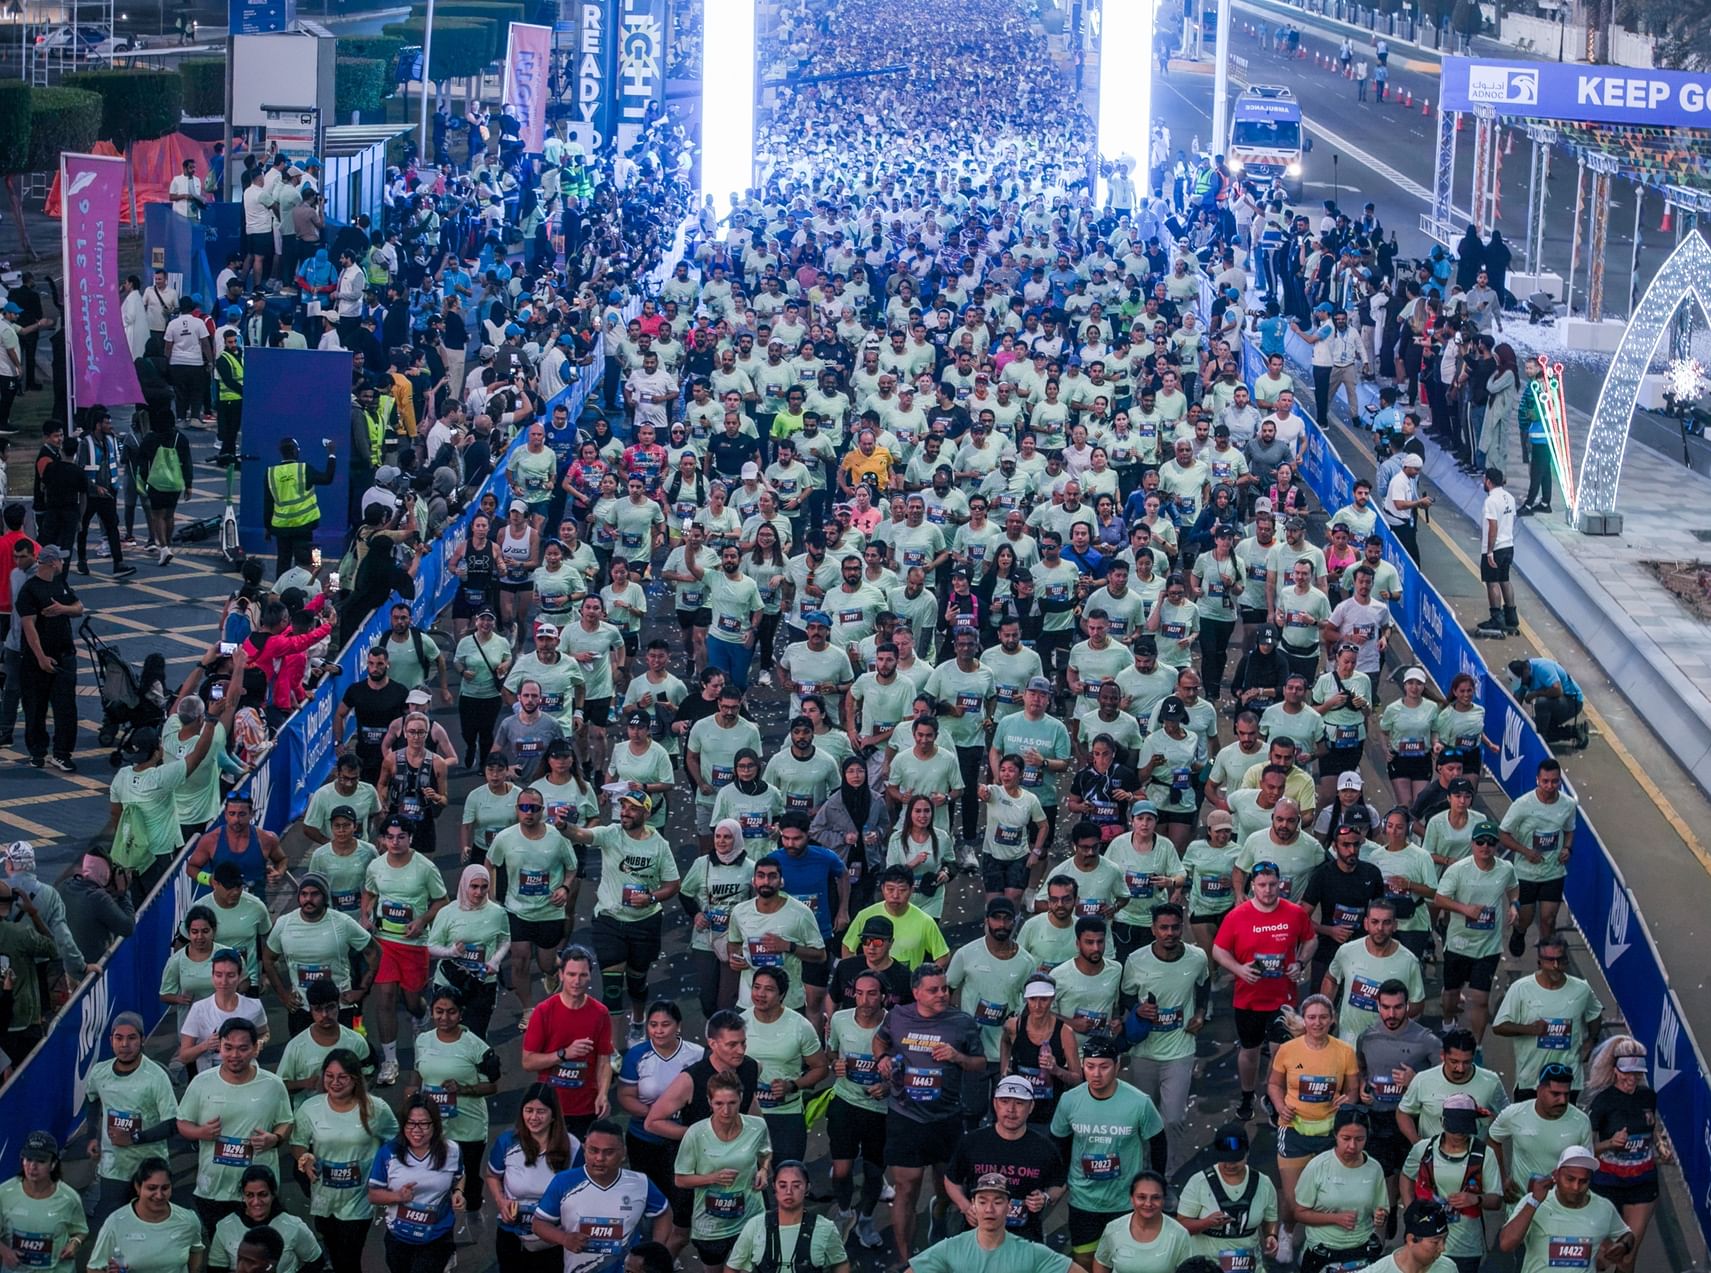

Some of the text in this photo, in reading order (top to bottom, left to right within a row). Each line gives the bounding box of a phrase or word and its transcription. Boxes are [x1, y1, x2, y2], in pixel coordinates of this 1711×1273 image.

[579, 4, 602, 122] READY
[1472, 91, 1504, 100] ADNOC
[1577, 75, 1671, 110] KEEP
[1007, 735, 1023, 743] RUN
[1023, 737, 1034, 745] AS
[625, 855, 652, 867] HUBBY
[712, 883, 741, 895] WIFEY
[912, 1076, 934, 1086] 16463
[1072, 1123, 1133, 1136] RUN AS ONE
[1088, 1136, 1112, 1145] CREW
[223, 1143, 245, 1154] 10296
[974, 1163, 1041, 1178] RUN AS ONE
[590, 1226, 613, 1237] 14714
[1559, 1246, 1584, 1257] 14422
